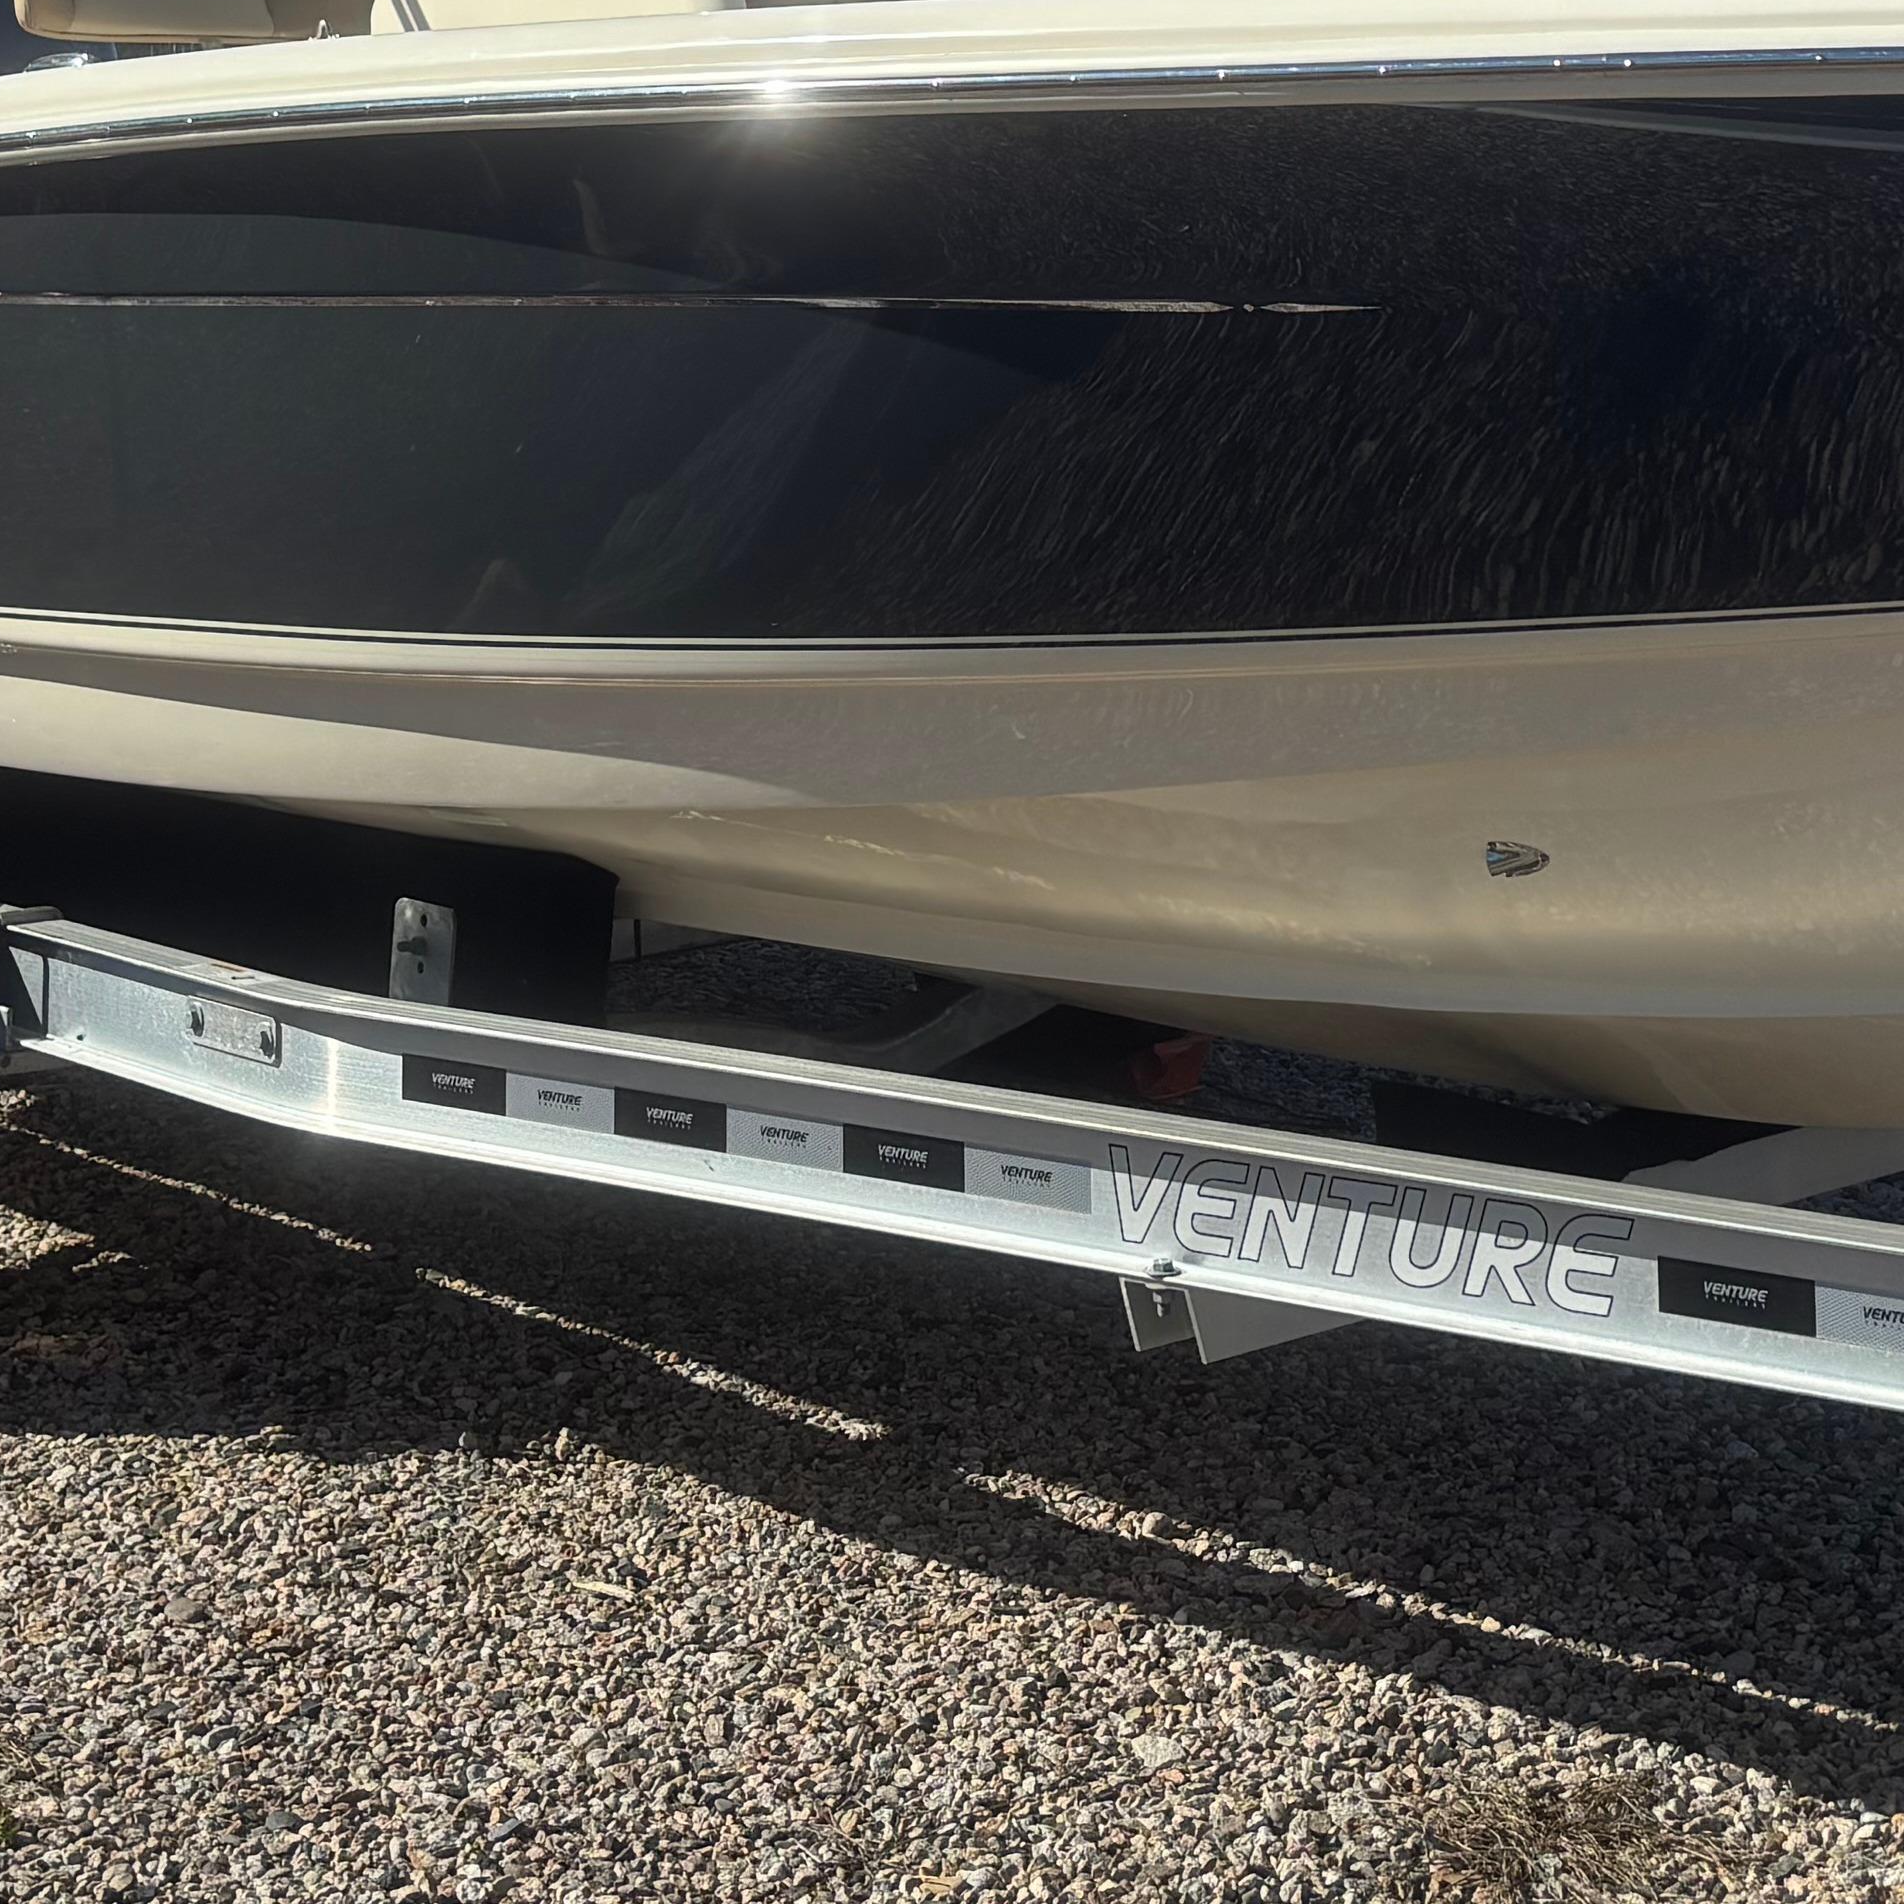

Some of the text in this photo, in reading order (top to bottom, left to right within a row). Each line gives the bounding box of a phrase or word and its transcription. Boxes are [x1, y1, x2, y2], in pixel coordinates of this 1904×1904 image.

[760, 1125, 809, 1143] VENTURE
[878, 1144, 928, 1163] VENTURE
[1000, 1164, 1053, 1182] VENTURE
[1107, 1143, 1635, 1318] VENTURE
[1703, 1280, 1769, 1303] VENTURE
